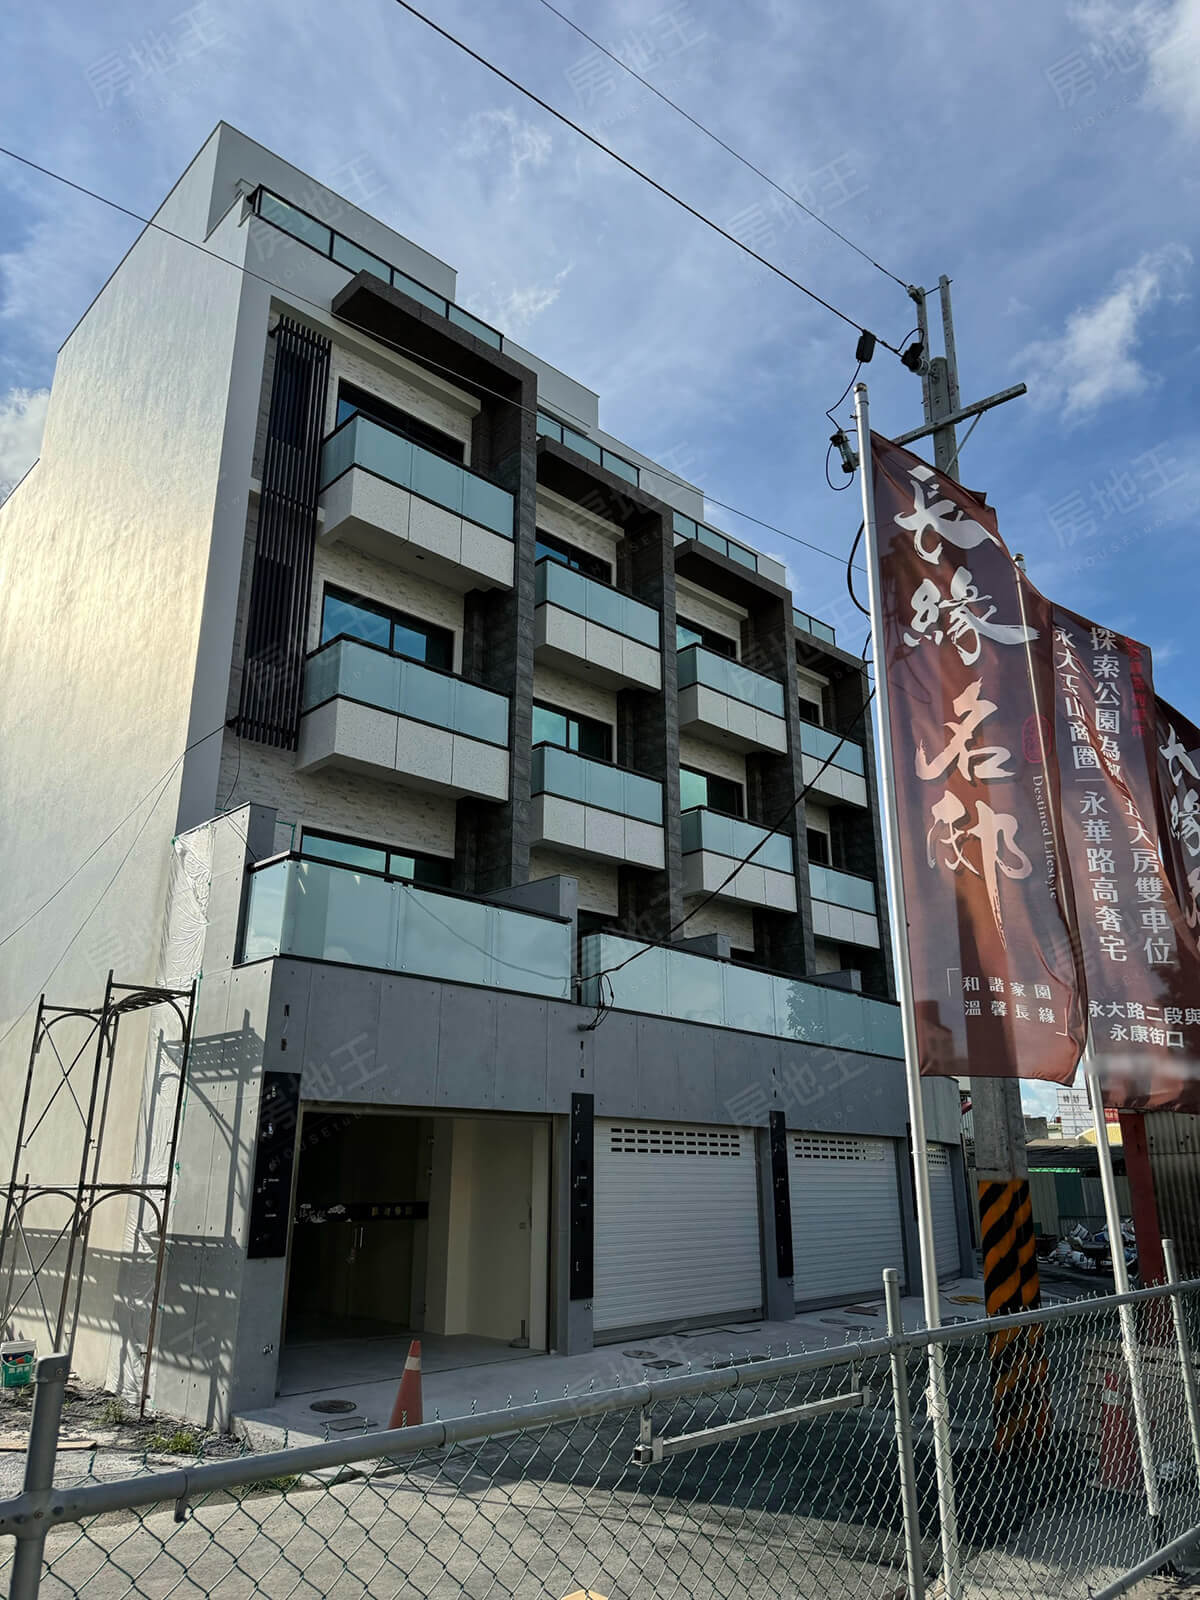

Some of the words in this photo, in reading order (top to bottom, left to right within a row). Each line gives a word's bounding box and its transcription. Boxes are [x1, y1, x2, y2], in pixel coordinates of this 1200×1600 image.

[1033, 776, 1052, 837] Destined
[1043, 840, 1057, 900] Lifestyle
[1080, 790, 1127, 962] 永華路高奢宅
[1088, 1000, 1200, 1025] 永大路二段與
[1109, 1023, 1184, 1048] 永康街口
